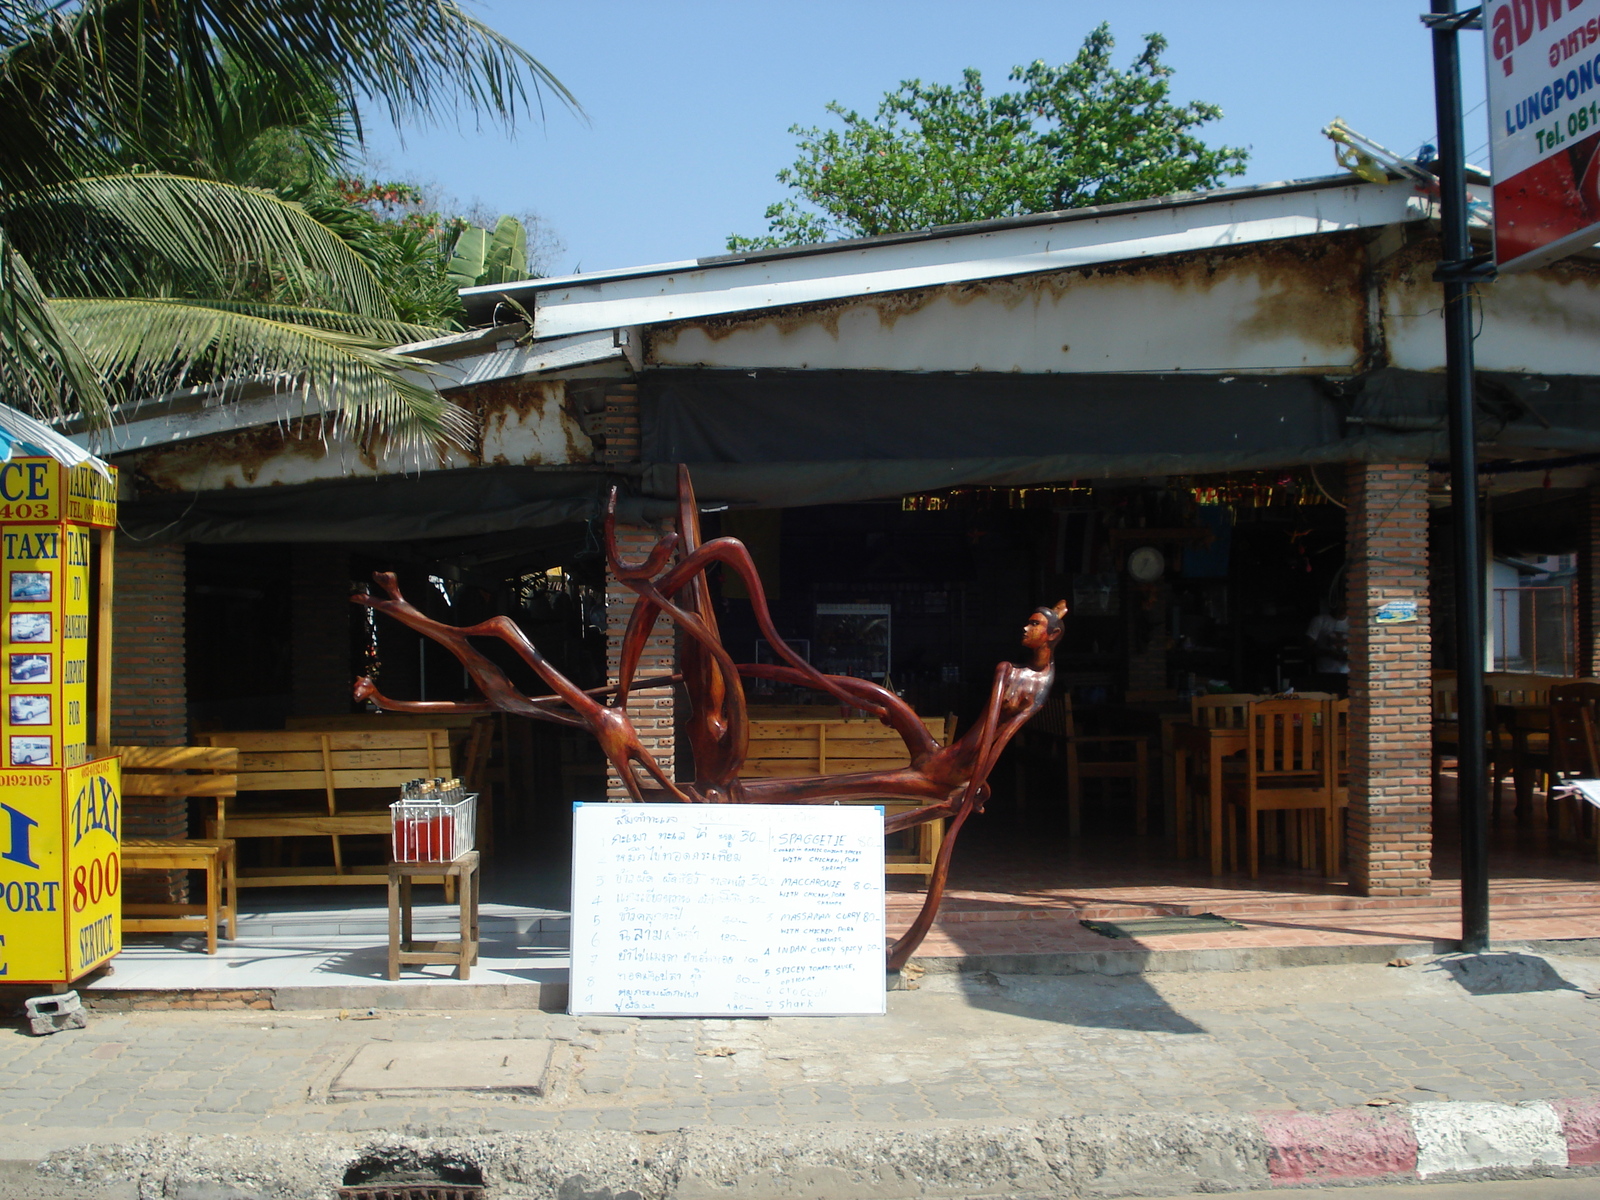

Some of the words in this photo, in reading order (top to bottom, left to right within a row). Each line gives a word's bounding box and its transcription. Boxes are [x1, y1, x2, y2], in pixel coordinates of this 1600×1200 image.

[1492, 0, 1583, 77] ลุงพ
[1536, 120, 1565, 154] Tel.
[0, 463, 49, 501] CE
[0, 504, 49, 518] 403
[69, 501, 82, 518] TEL.
[4, 533, 58, 559] TAXI
[67, 531, 88, 566] TAXI
[73, 576, 81, 600] TO
[69, 701, 81, 725] FOR
[71, 775, 119, 847] TAXI
[73, 852, 119, 914] 800
[593, 914, 601, 926] 5
[79, 913, 113, 969] SERVICE
[764, 968, 771, 977] 5
